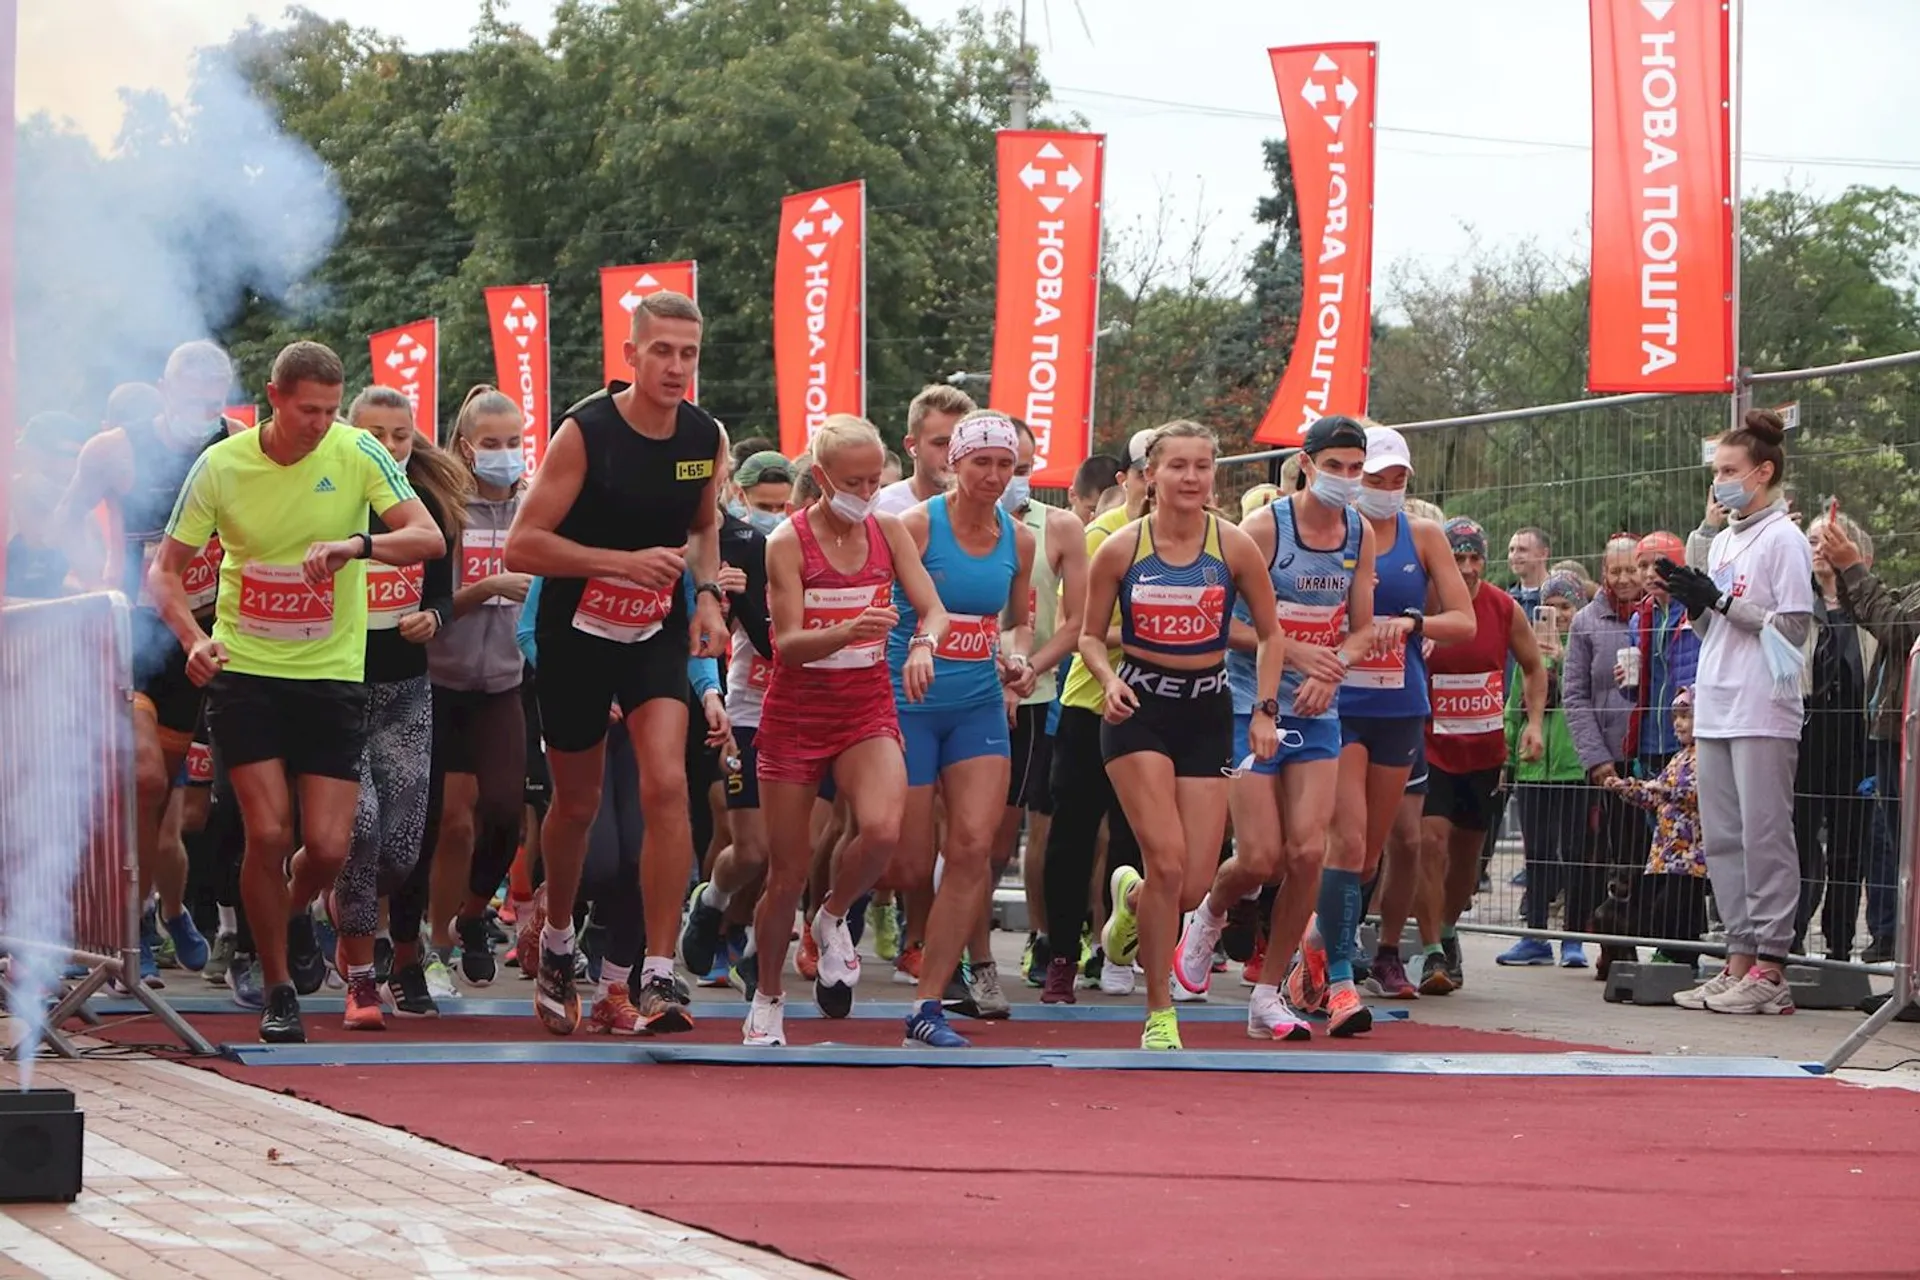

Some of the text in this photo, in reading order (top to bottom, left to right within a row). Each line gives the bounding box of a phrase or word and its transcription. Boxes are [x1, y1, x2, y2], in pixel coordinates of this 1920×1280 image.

[1641, 31, 1679, 375] НОВА ПОШТА
[1034, 219, 1065, 326] НОВА
[517, 352, 537, 486] НОВА ПО
[368, 580, 407, 601] 126
[1296, 576, 1346, 590] UKRAINE
[243, 587, 314, 613] 21227
[586, 588, 657, 618] 21194
[1136, 613, 1207, 636] 21230
[946, 631, 983, 652] 200
[1437, 694, 1492, 713] 21050
